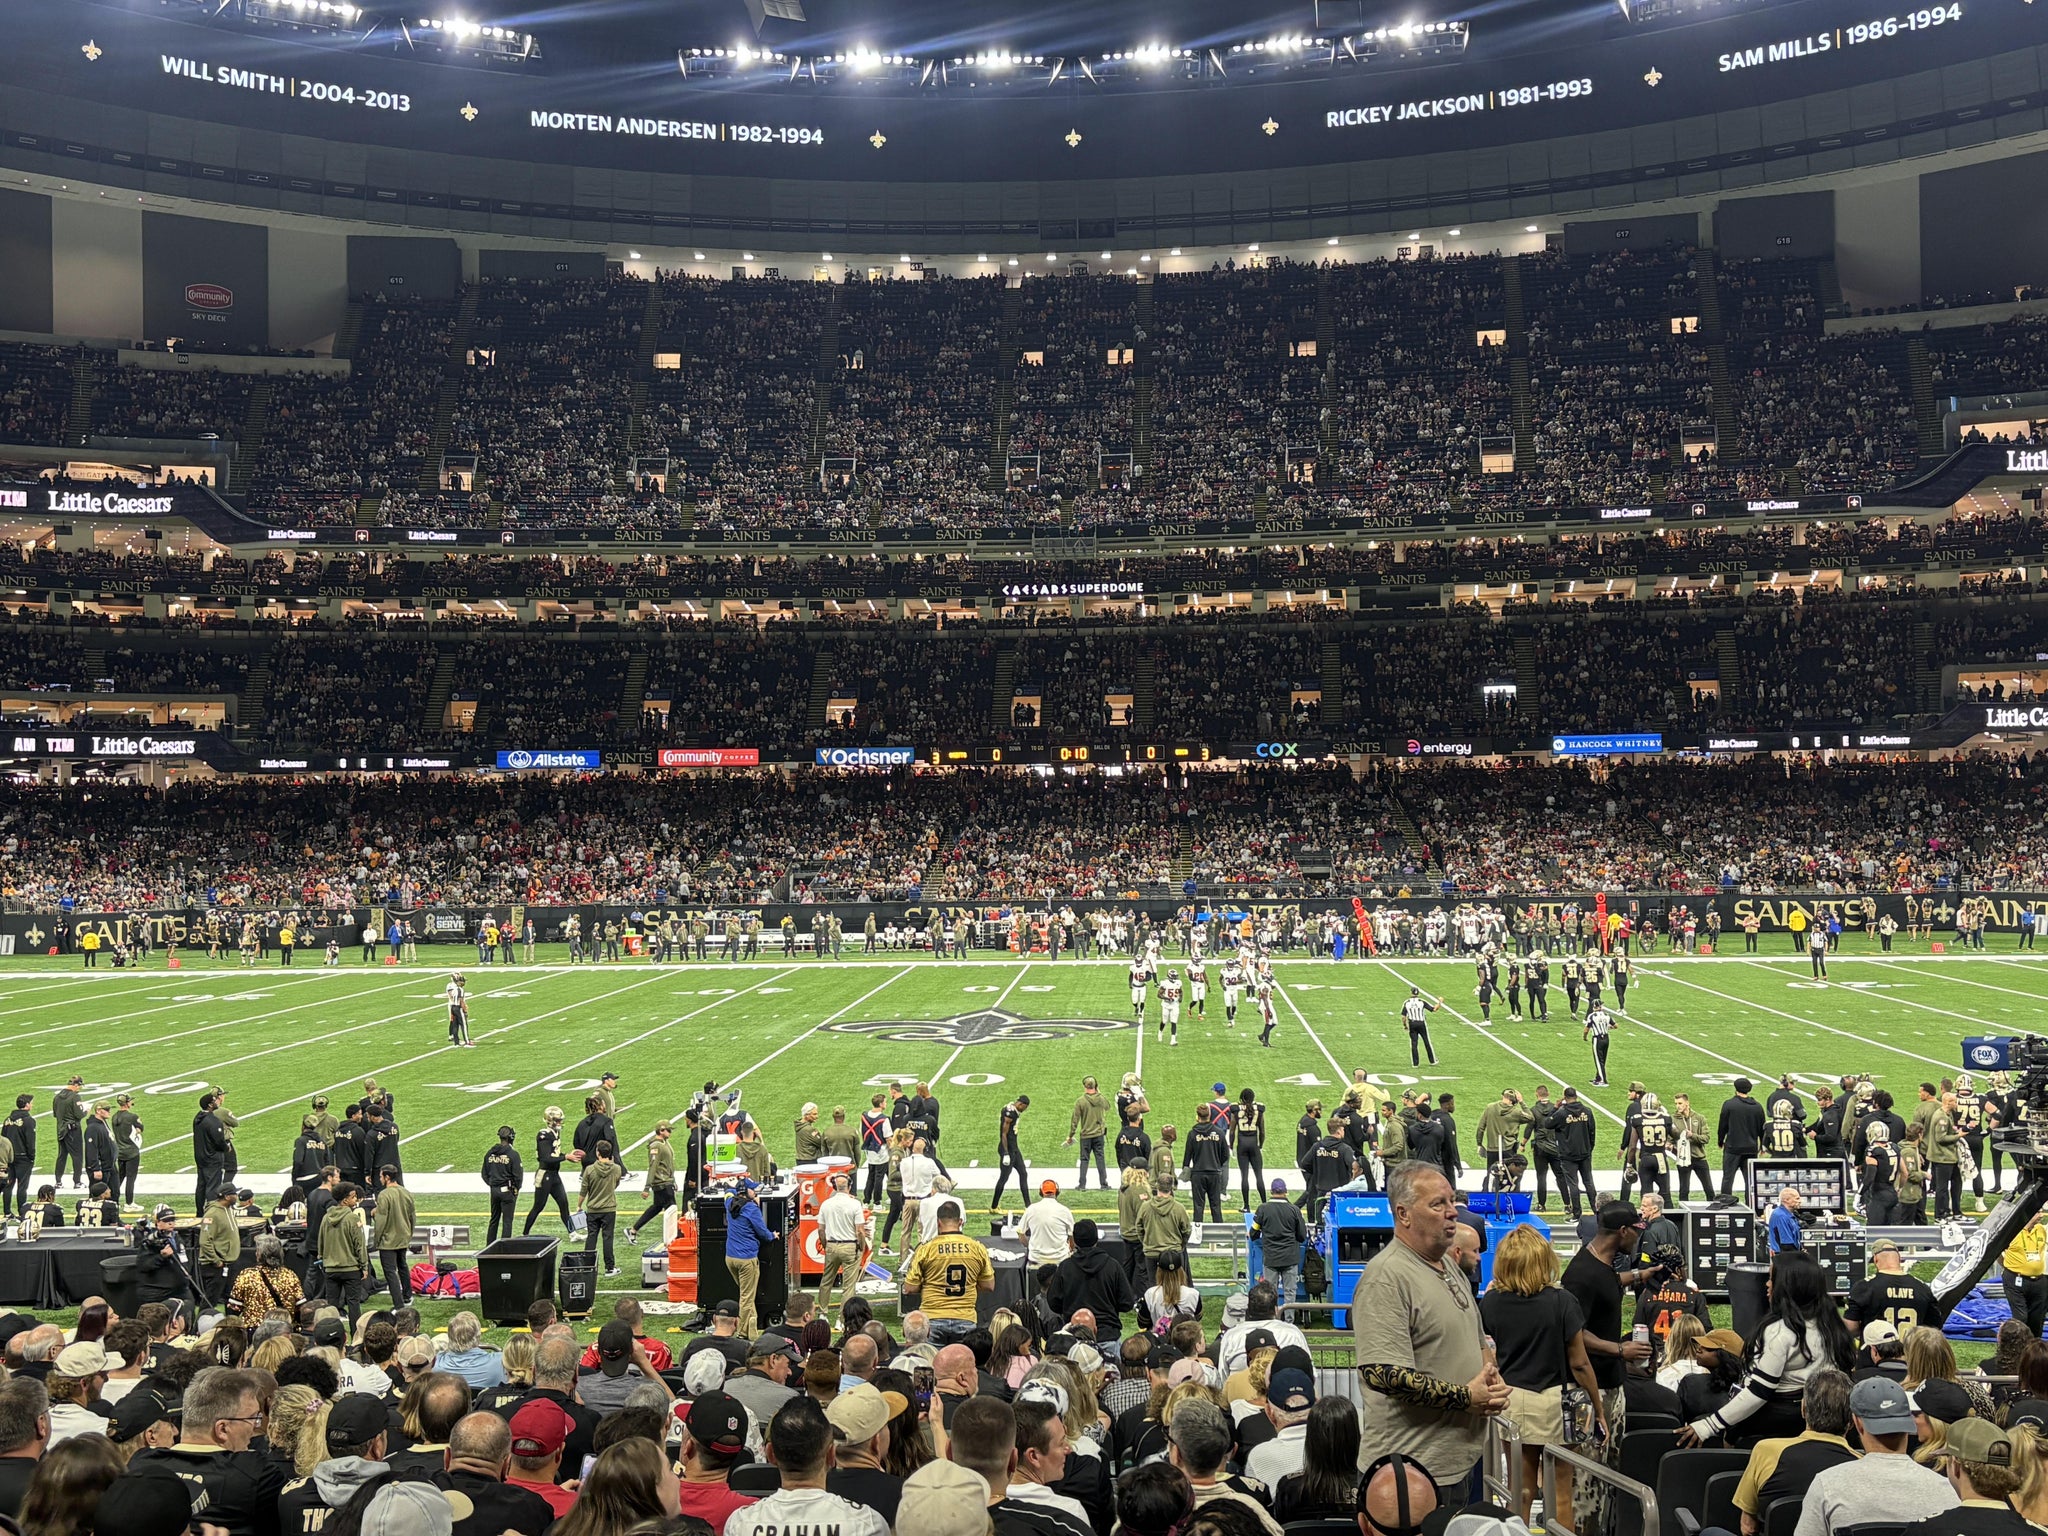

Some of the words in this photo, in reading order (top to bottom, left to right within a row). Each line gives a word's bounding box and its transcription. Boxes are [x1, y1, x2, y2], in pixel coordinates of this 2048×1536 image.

[1718, 51, 1766, 73] SAM
[1768, 33, 1832, 65] MILLS
[1846, 3, 1963, 45] 1986-1994
[161, 54, 214, 82] WILL
[217, 64, 286, 94] SMITH
[299, 79, 411, 112] 2004-2013
[1326, 104, 1394, 128] RICKEY
[1397, 94, 1484, 121] JACKSON
[1498, 78, 1593, 108] 1981-1993
[531, 110, 612, 131] MORTEN
[616, 117, 717, 140] ANDERSEN
[730, 124, 824, 145] 1982-1994
[188, 289, 231, 304] Community
[192, 312, 206, 321] SKY
[207, 314, 226, 322] DECK
[48, 490, 103, 512] Little
[103, 492, 173, 513] Caesars
[1363, 516, 1413, 528] SAINTS
[1474, 511, 1524, 523] SAINTS
[1149, 525, 1196, 536] SAINTS
[1255, 520, 1303, 532] SAINTS
[614, 530, 663, 541] SAINTS
[723, 530, 771, 541] SAINTS
[829, 530, 877, 541] SAINTS
[936, 528, 982, 540] SAINTS
[1809, 556, 1860, 567] SAINTS
[1924, 550, 1976, 561] SAINTS
[1590, 565, 1638, 576] SAINTS
[1699, 561, 1748, 572] SAINTS
[0, 576, 37, 587] AINTS
[1380, 574, 1426, 585] SAINTS
[1484, 570, 1531, 581] SAINTS
[101, 580, 151, 592] SAINTS
[1002, 584, 1068, 596] CAESARS
[1070, 582, 1143, 594] SUPERDOME
[1182, 581, 1226, 591] SAINTS
[1282, 578, 1326, 588] SAINTS
[210, 585, 259, 596] SAINTS
[318, 586, 365, 597] SAINTS
[422, 586, 468, 597] SAINTS
[525, 587, 571, 598] SAINTS
[625, 587, 670, 598] SAINTS
[725, 587, 768, 598] SAINTS
[822, 587, 865, 598] SAINTS
[919, 586, 962, 597] SAINTS
[1986, 708, 2029, 728] Little
[92, 737, 138, 754] Little
[139, 737, 195, 755] Caesars
[1256, 742, 1298, 757] COX
[1332, 742, 1380, 753] SAINTS
[1423, 743, 1472, 755] entergy
[1569, 740, 1612, 748] HANCOCK
[1616, 739, 1662, 748] WHITNEY
[605, 752, 653, 763] SAINTS
[663, 750, 723, 766] Community
[832, 748, 911, 765] Ochsner
[932, 753, 940, 765] 3
[992, 749, 1000, 761] 0
[1060, 748, 1087, 760] 0:10
[1147, 747, 1155, 759] 0
[1201, 748, 1210, 760] 3
[532, 753, 589, 766] Allstate
[1734, 900, 1863, 927] SAINTS
[437, 921, 466, 929] SERVIC
[1976, 1050, 1994, 1060] FOX
[1957, 1104, 1980, 1126] 79
[1642, 1126, 1666, 1147] 83
[1772, 1130, 1793, 1152] 10
[1354, 1206, 1380, 1215] Copilot
[80, 1208, 103, 1228] 33
[938, 1244, 970, 1254] BREES
[945, 1264, 967, 1297] 9
[1887, 1287, 1914, 1299] OLAVE
[753, 1524, 842, 1536] GRAHAM
